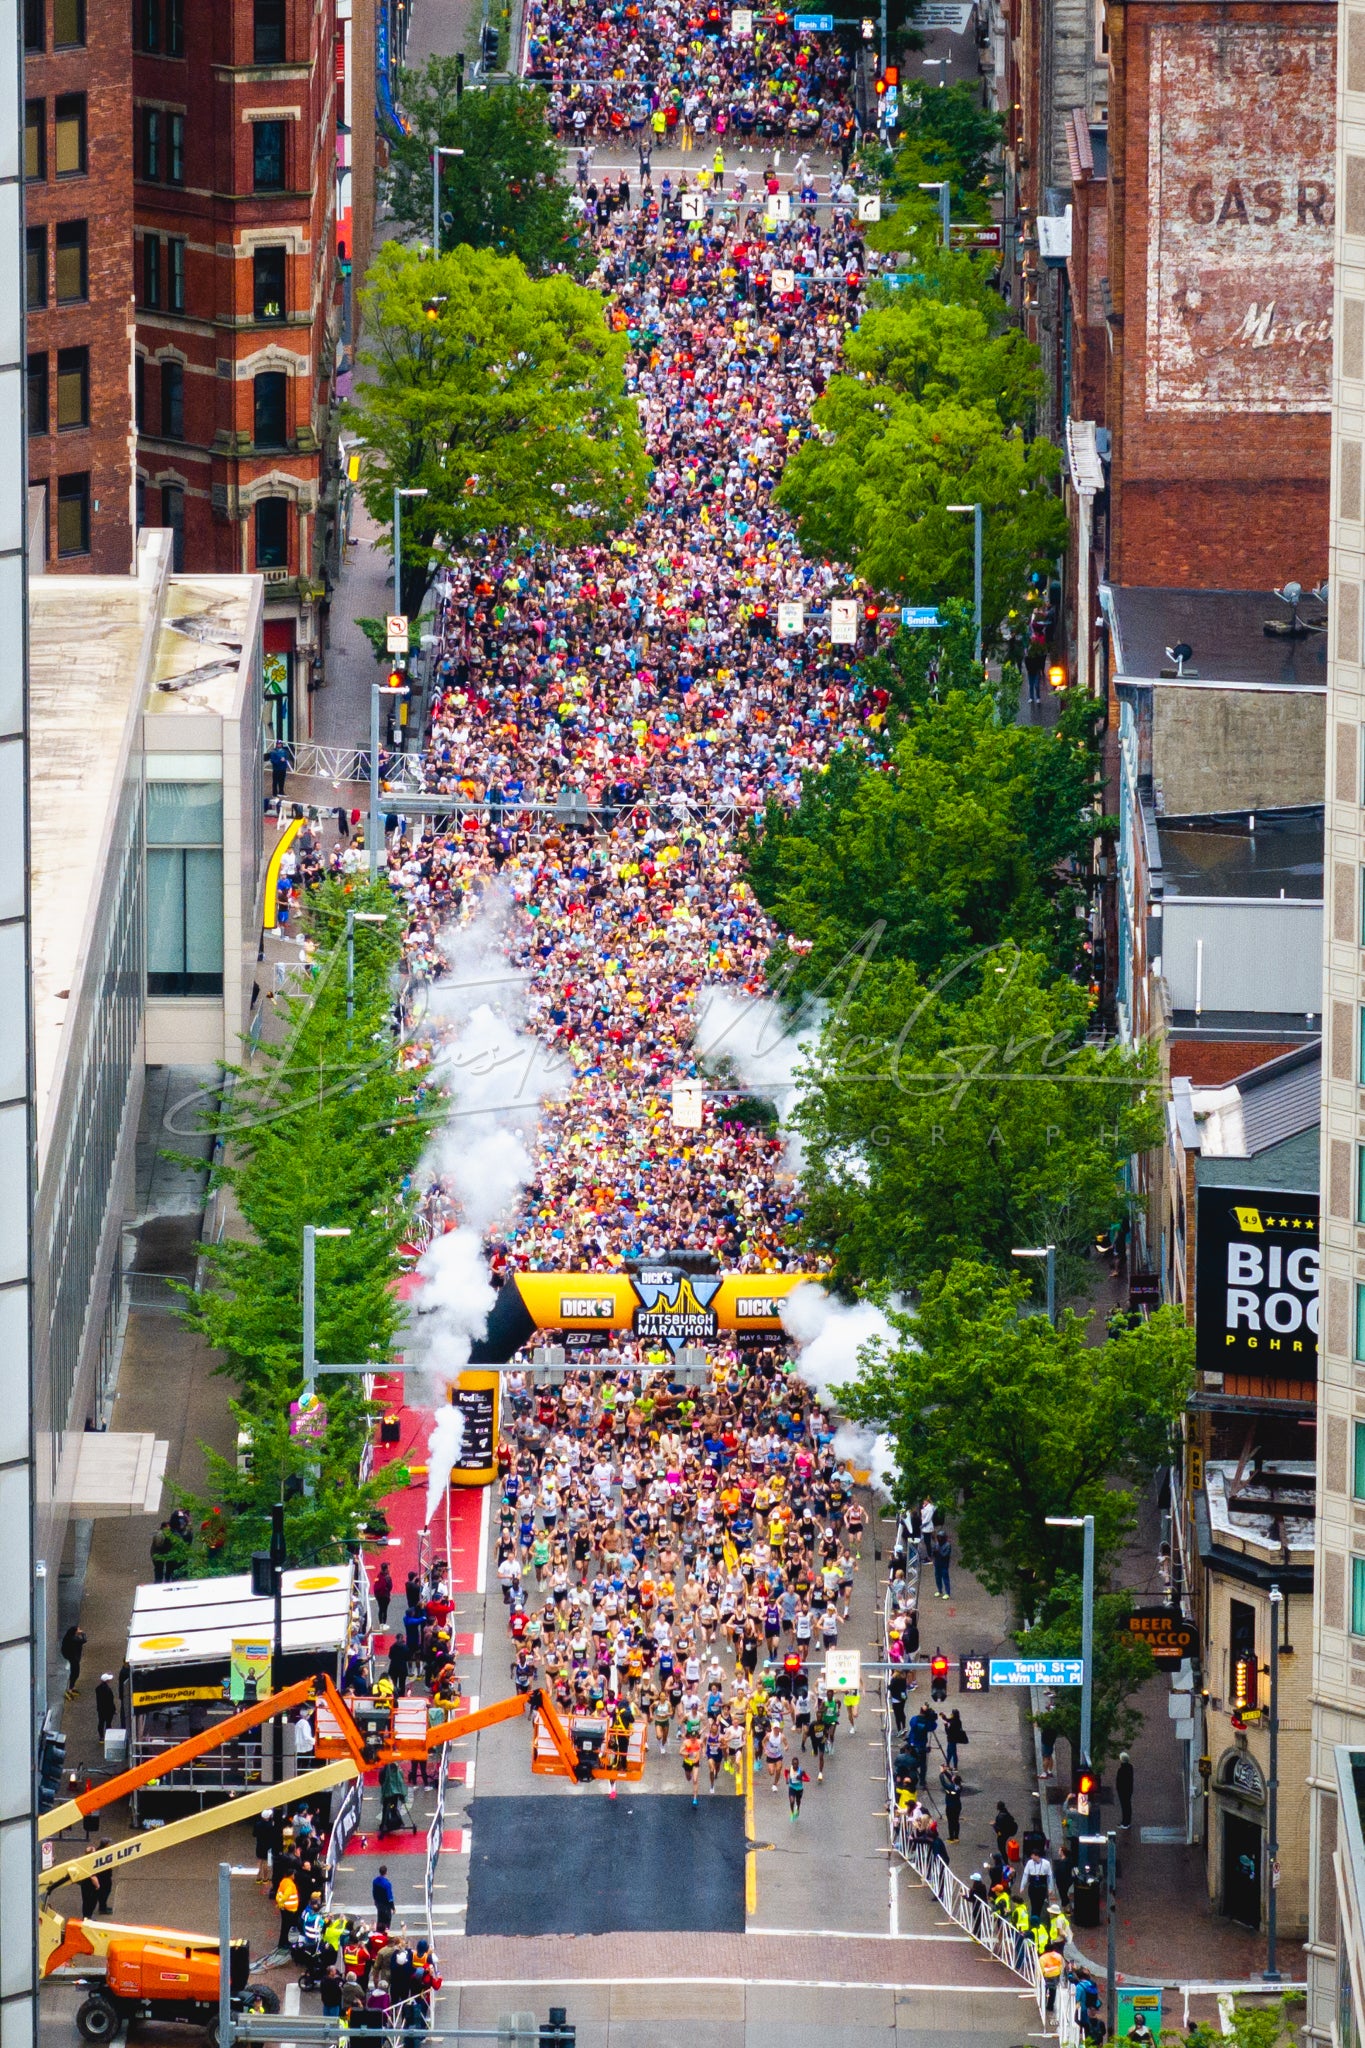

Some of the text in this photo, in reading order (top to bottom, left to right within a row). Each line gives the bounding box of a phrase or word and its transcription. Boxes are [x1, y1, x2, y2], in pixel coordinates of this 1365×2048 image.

[1188, 177, 1335, 225] GAS R
[1242, 1215, 1258, 1225] 4.9
[1227, 1242, 1320, 1291] BIG
[641, 1271, 673, 1285] DICK'S
[562, 1299, 612, 1317] DICK'S
[637, 1313, 714, 1325] PITTSBURGH
[637, 1324, 714, 1336] MARATHON
[1129, 1617, 1173, 1631] BEER
[966, 1661, 982, 1670] NO
[1013, 1662, 1065, 1673] Tenth St
[964, 1669, 985, 1677] TURN
[1008, 1672, 1081, 1683] Wm Penn Pl
[966, 1682, 982, 1690] RED
[139, 1689, 196, 1702] #RunPlayPGH
[92, 1842, 142, 1869] JLG LIFT
